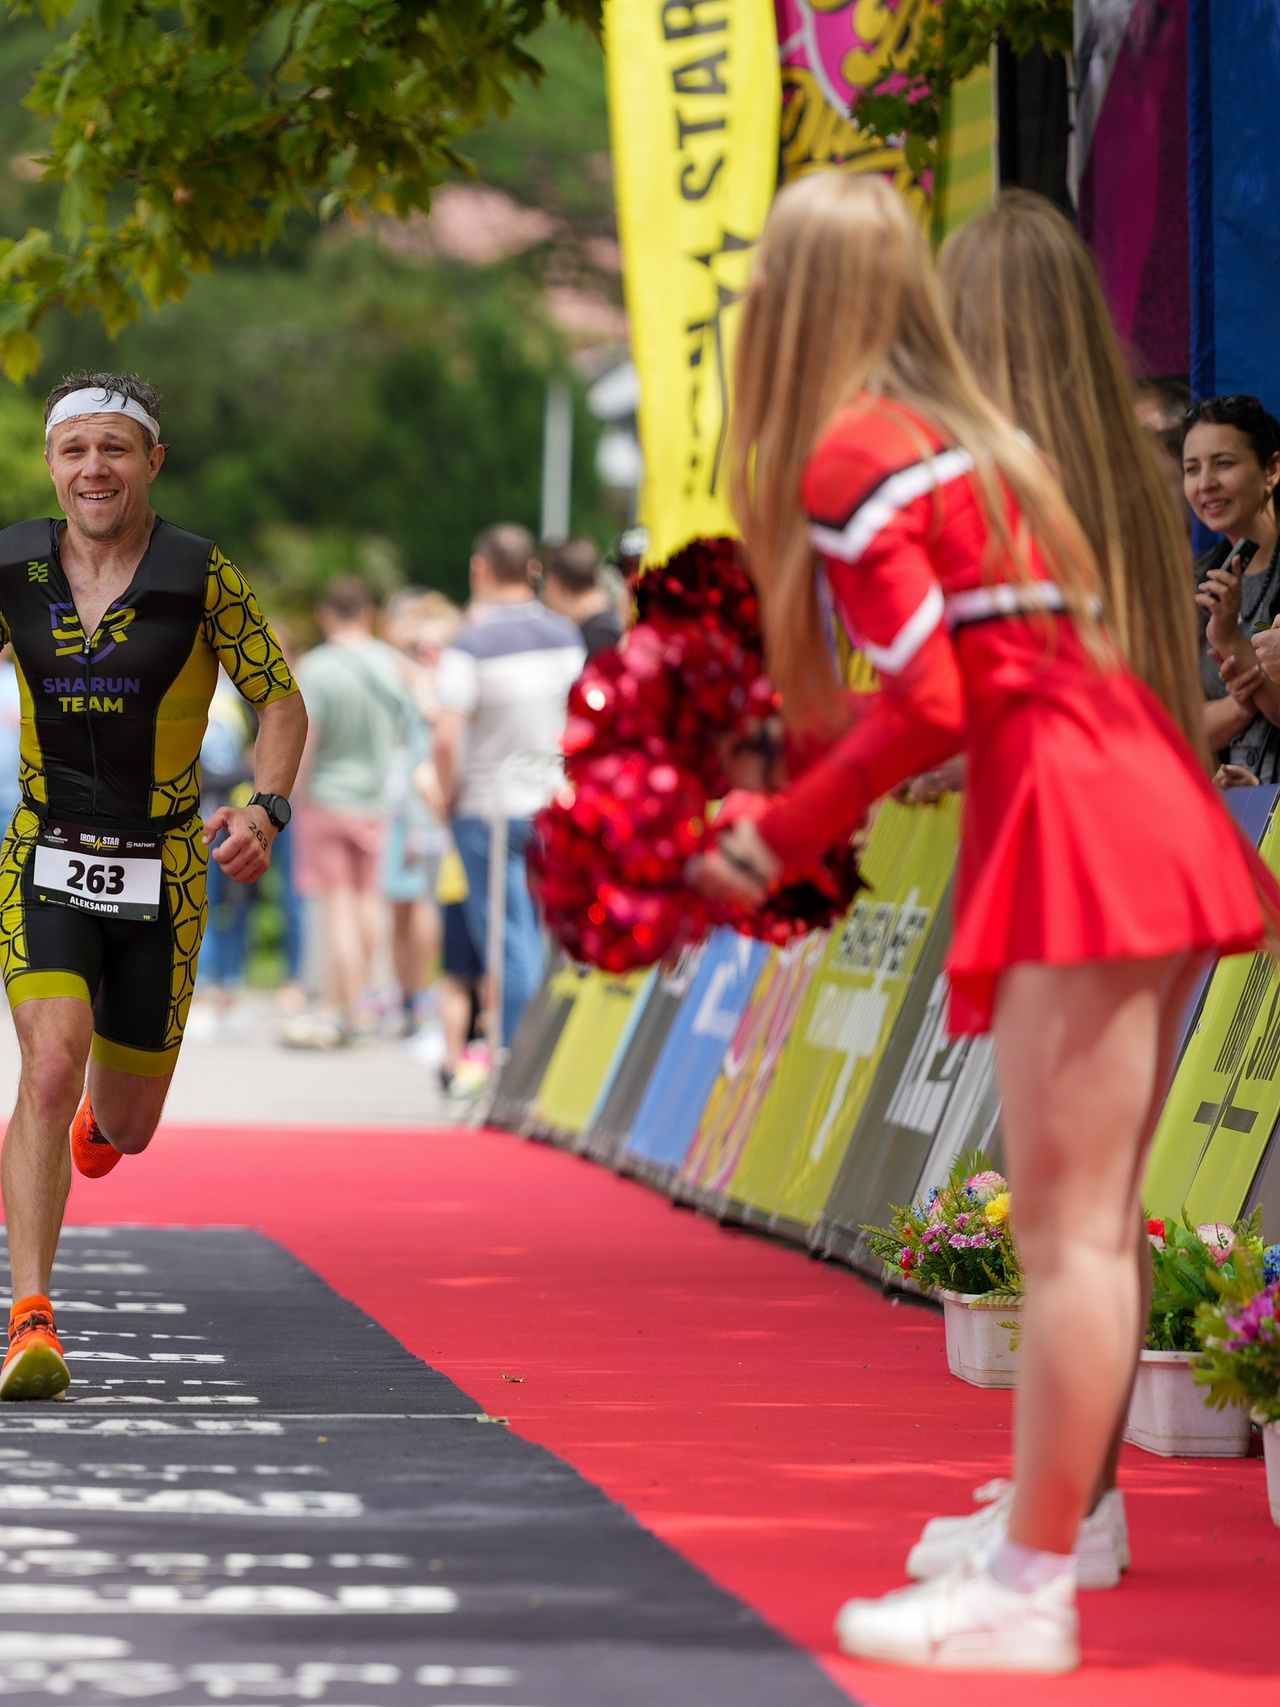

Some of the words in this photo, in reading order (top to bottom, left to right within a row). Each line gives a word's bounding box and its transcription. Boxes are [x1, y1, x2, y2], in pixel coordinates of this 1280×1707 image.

[662, 0, 727, 200] STAR
[43, 677, 140, 694] SHARUN
[59, 696, 123, 713] TEAM
[80, 833, 96, 844] IRON
[102, 836, 121, 846] STAR
[249, 821, 268, 851] 263
[66, 859, 125, 895] 263
[69, 896, 119, 913] ALEKSANDR
